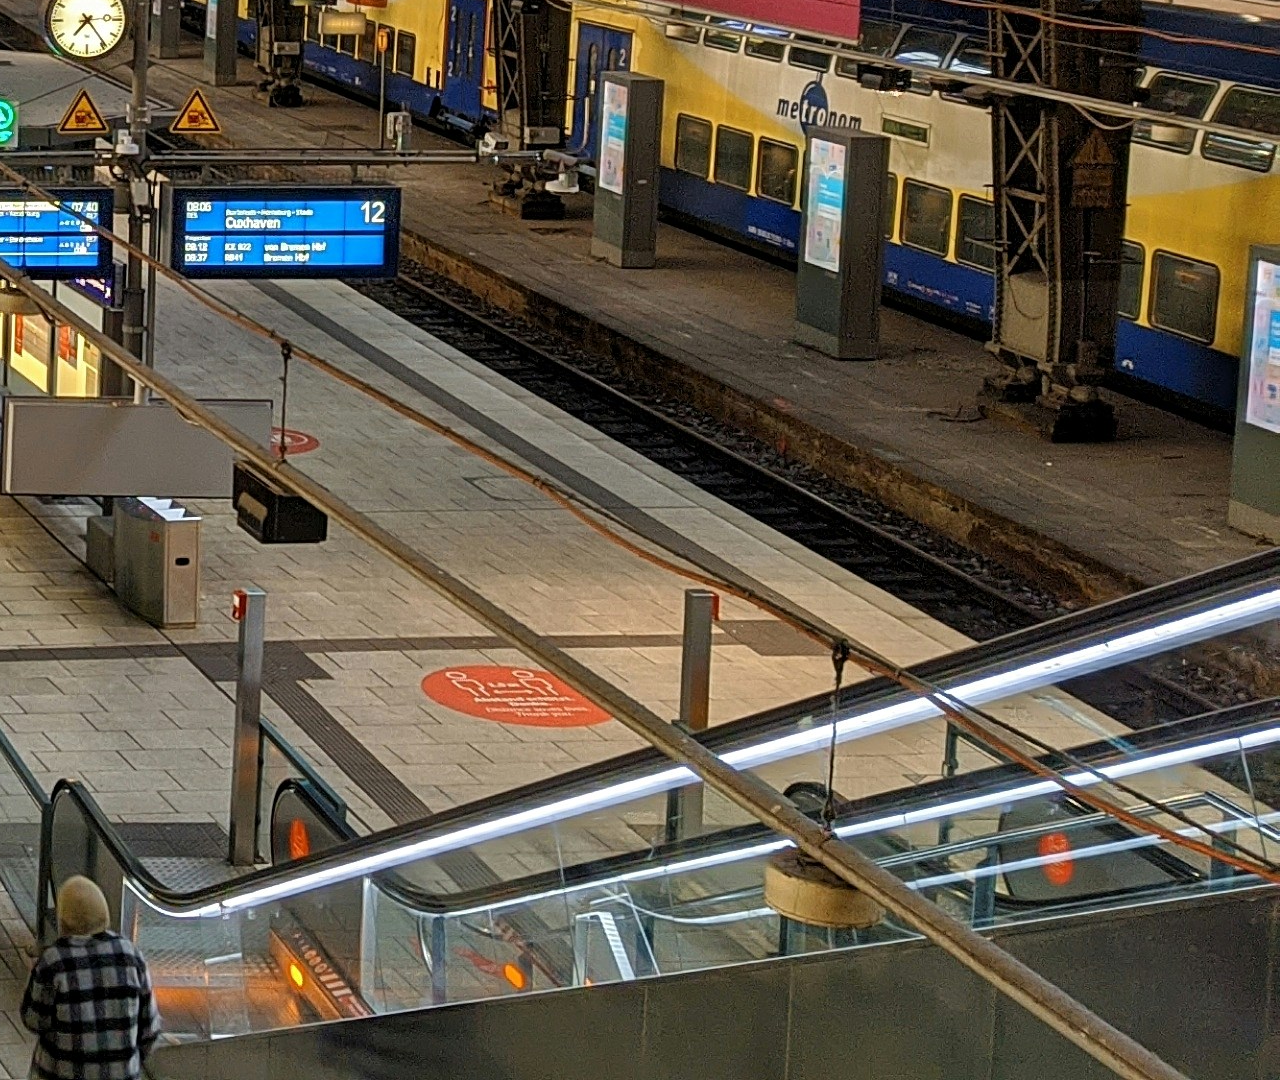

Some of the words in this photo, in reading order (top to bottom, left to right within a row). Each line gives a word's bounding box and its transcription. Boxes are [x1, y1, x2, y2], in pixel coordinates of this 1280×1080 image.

[618, 47, 626, 67] 2
[776, 98, 862, 131] metronom
[225, 217, 281, 229] Cuxhaven
[360, 201, 386, 224] 12
